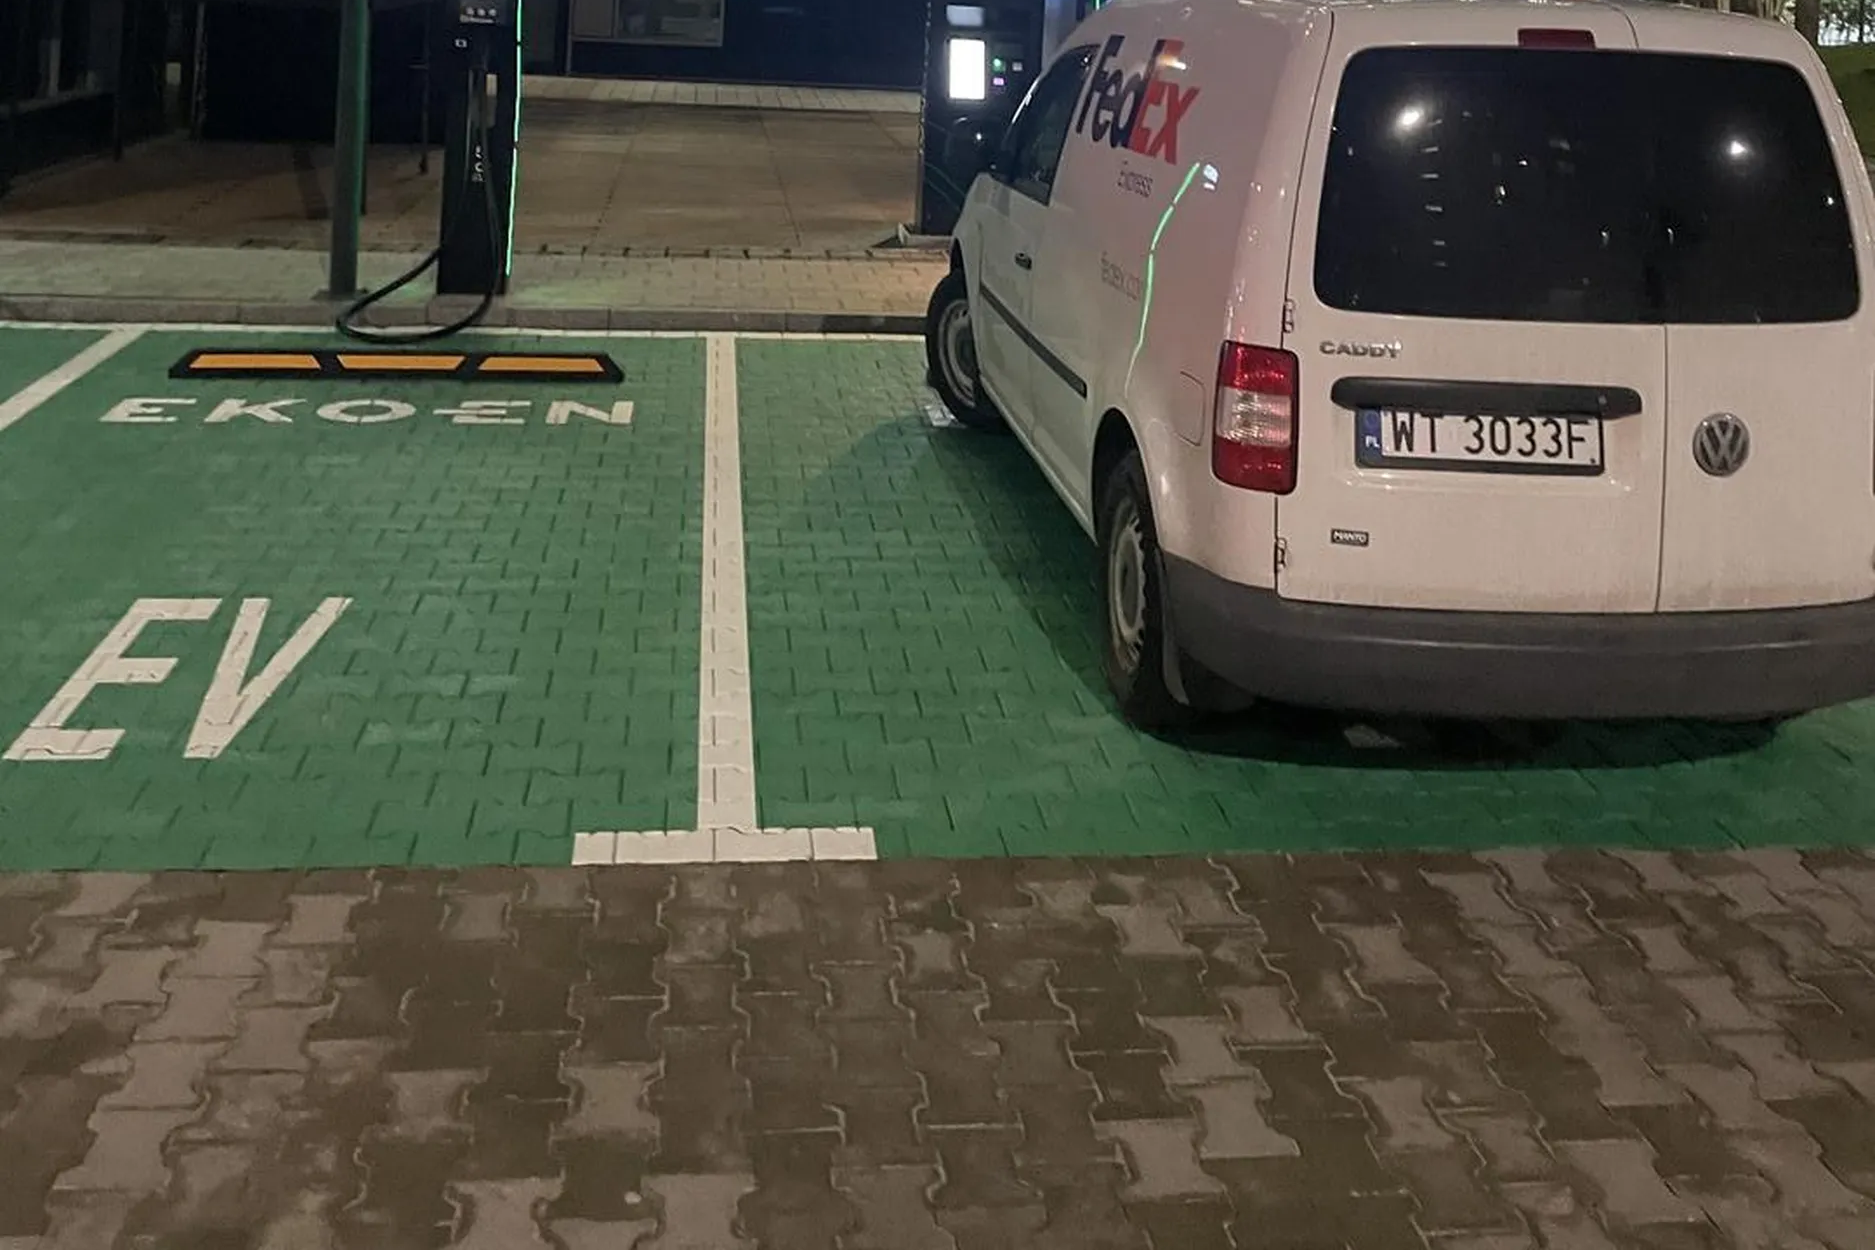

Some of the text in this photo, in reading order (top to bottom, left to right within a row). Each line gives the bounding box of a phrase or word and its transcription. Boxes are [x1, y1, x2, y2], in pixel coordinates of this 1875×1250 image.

[1076, 34, 1201, 166] FedEx
[1319, 340, 1402, 359] CADDY
[99, 397, 636, 426] EKOEN
[1364, 434, 1381, 449] PL
[1391, 408, 1591, 459] WT 3033F
[2, 596, 354, 761] EV
